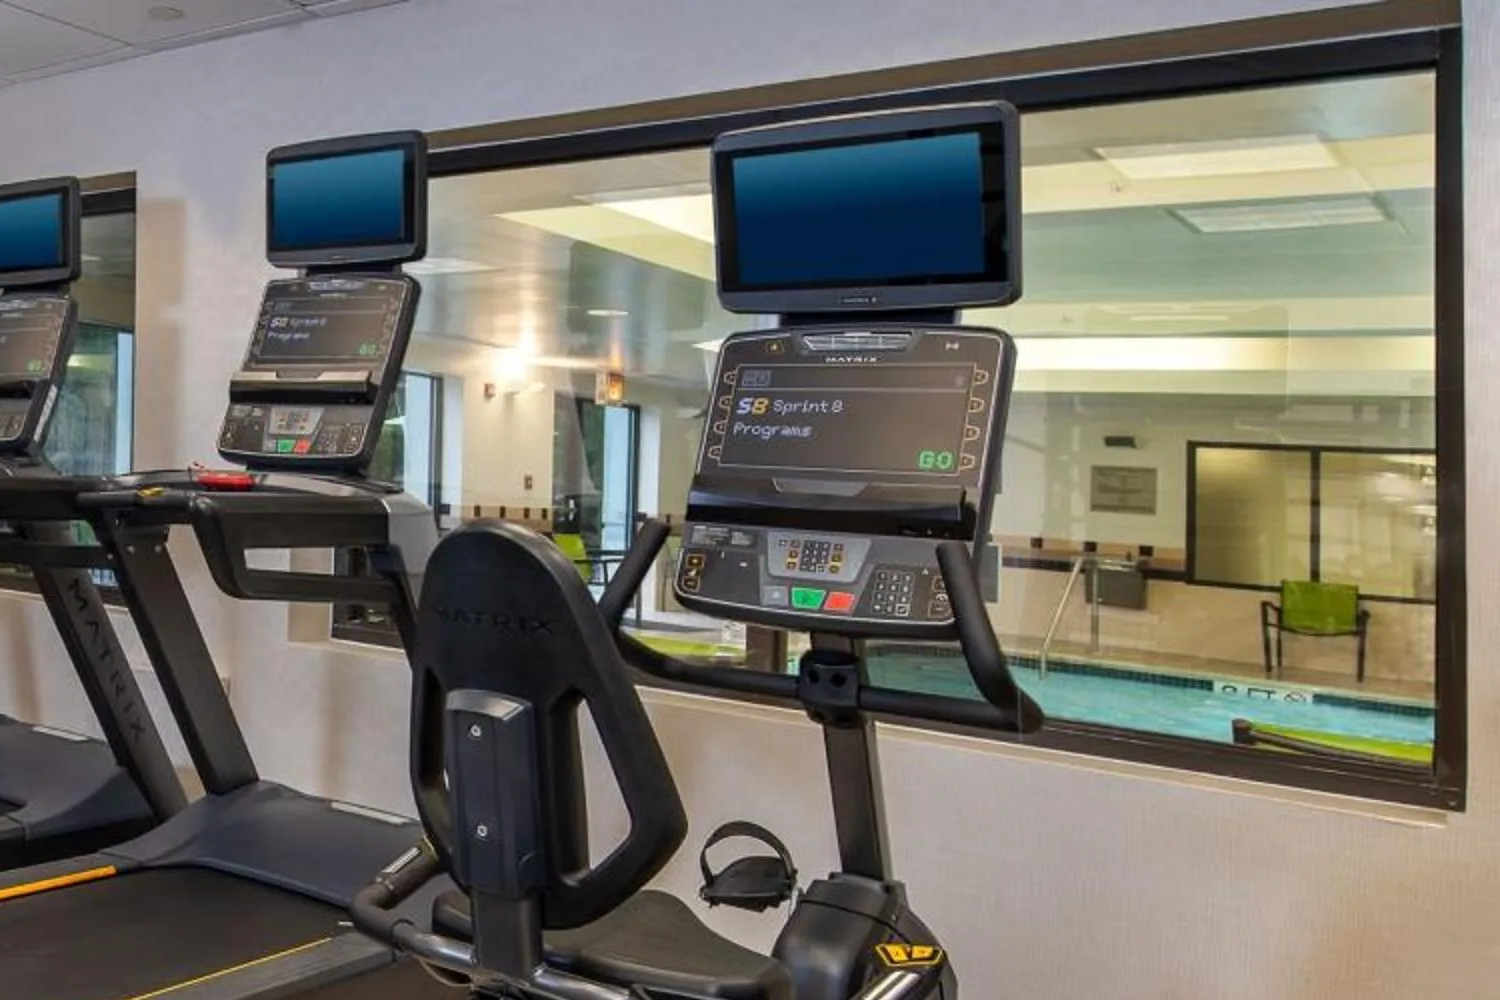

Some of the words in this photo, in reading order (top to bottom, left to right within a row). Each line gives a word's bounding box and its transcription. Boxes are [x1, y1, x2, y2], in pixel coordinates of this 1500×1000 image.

[772, 399, 830, 416] Sprint
[733, 421, 814, 440] Programs
[917, 451, 953, 470] GO
